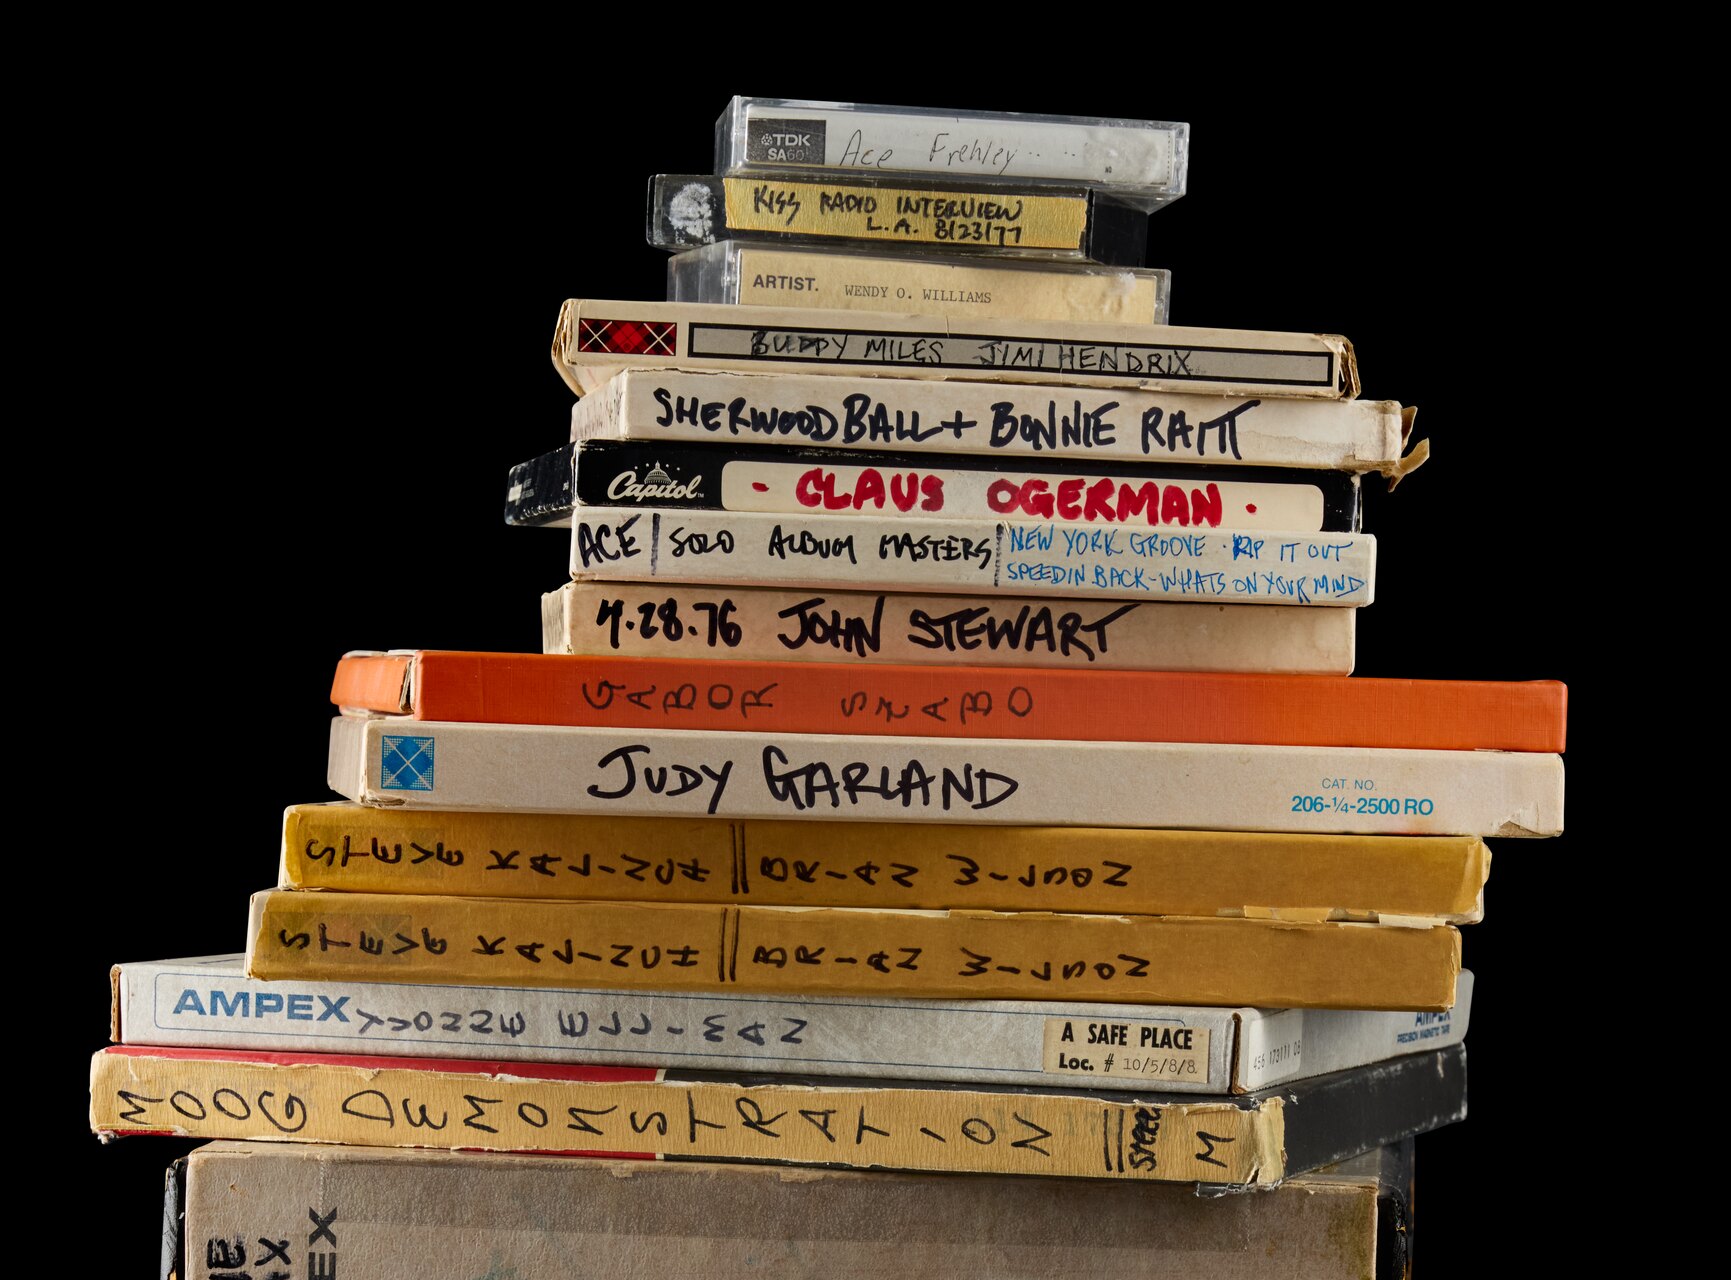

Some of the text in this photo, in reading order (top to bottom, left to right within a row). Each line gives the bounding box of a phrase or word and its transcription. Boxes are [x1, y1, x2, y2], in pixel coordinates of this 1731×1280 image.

[772, 133, 811, 146] TDK
[839, 129, 1018, 175] Ace Frehley
[753, 186, 1022, 225] KISS RADIO INTERVIEW
[866, 216, 1022, 244] L.A. 8/23/77
[752, 274, 819, 293] ARTIST.
[845, 284, 992, 304] WENDY O. WILLIAMS
[750, 330, 1193, 376] BUDDY MILES JIMI HENDRIX
[989, 400, 1120, 450] BONNIE
[1140, 399, 1261, 460] RAITT
[606, 469, 701, 501] Capitol
[795, 466, 1223, 528] CLAUS OGERMAN
[577, 513, 992, 570] ACE SOLO ALBUM MASTERS
[1009, 524, 1054, 554] NEW
[1062, 527, 1123, 557] YORK
[1130, 529, 1206, 558] GROOVE
[1279, 542, 1301, 563] IT
[1307, 540, 1355, 563] OUT
[1233, 577, 1259, 595] ON
[1263, 573, 1310, 604] YOUR
[1313, 576, 1366, 598] MIND
[777, 594, 885, 658] JOHN
[907, 601, 1141, 661] STEWART
[582, 679, 1034, 725] GABOR SZABO
[586, 744, 1020, 815] JUDY GARLAND
[1321, 777, 1378, 791] CAT. NO.
[305, 834, 465, 867] STEVE
[759, 854, 920, 888] BRIAN
[946, 852, 1133, 888] WILSON
[278, 923, 448, 956] STEVE
[752, 944, 923, 974] BRIAN
[957, 946, 1151, 980] WILSON
[172, 988, 353, 1023] AMPEX
[355, 1008, 808, 1043] YVONNE ELLIMAN
[1060, 1021, 1193, 1051] A SAFE PLACE
[116, 1087, 1054, 1157] MOOG DEMONSTRATION
